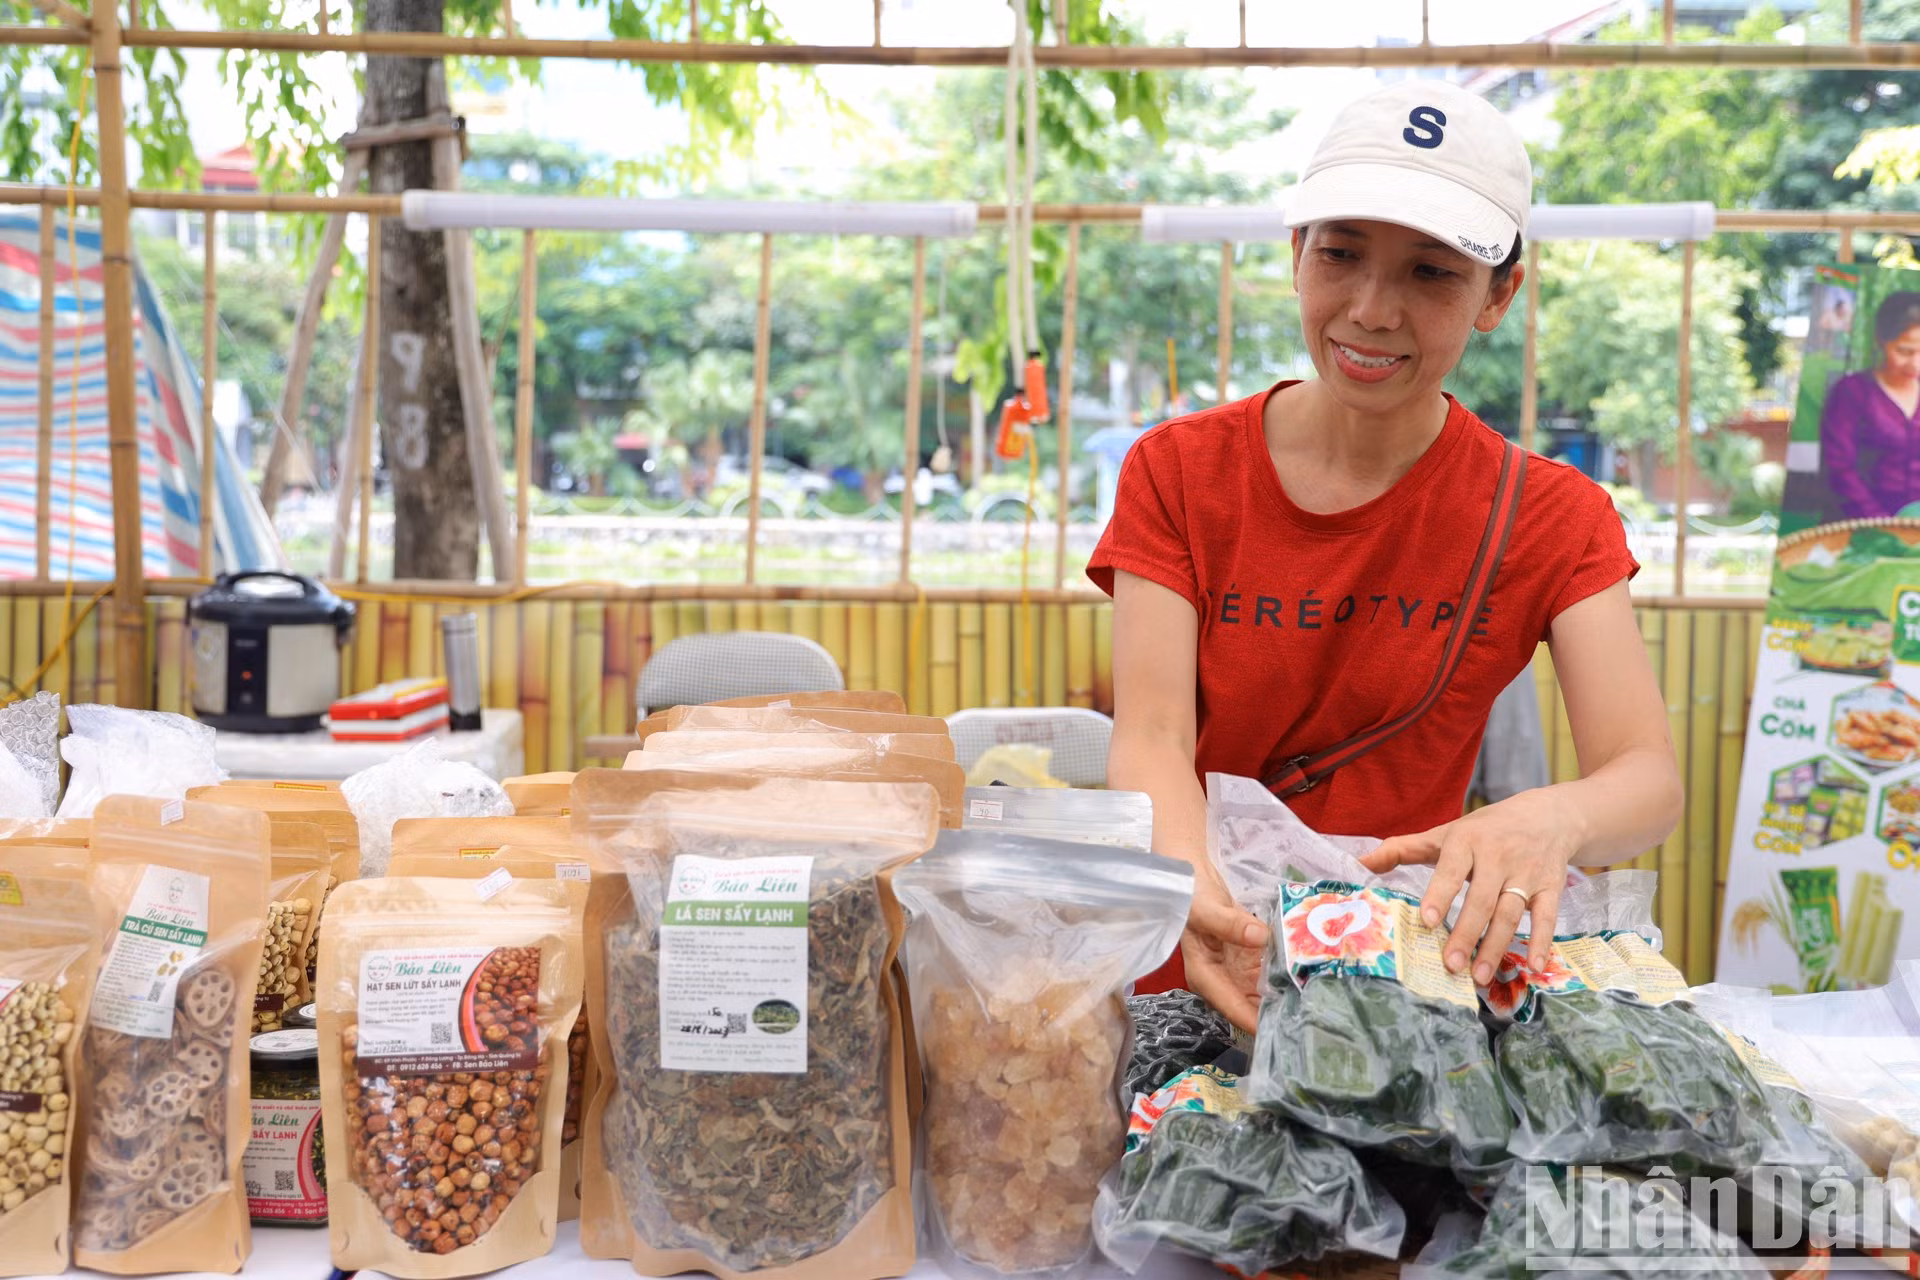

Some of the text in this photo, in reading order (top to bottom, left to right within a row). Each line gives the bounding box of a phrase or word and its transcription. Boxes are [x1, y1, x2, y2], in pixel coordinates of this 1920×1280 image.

[1402, 105, 1448, 149] S
[1458, 235, 1490, 260] SHARE
[755, 878, 798, 893] Liên
[170, 913, 194, 927] Liên
[675, 903, 794, 926] LÁ SEN SẤY LẠNH
[125, 920, 203, 945] TRÀ CỦ SEN SẤY LẠNH
[394, 959, 462, 976] Bảo Liên
[366, 982, 383, 993] HẠT
[385, 981, 401, 991] SEN
[421, 977, 437, 989] SẤY
[439, 979, 461, 990] LẠNH
[268, 1112, 300, 1126] Liên
[252, 1128, 297, 1141] SẤY LẠNH
